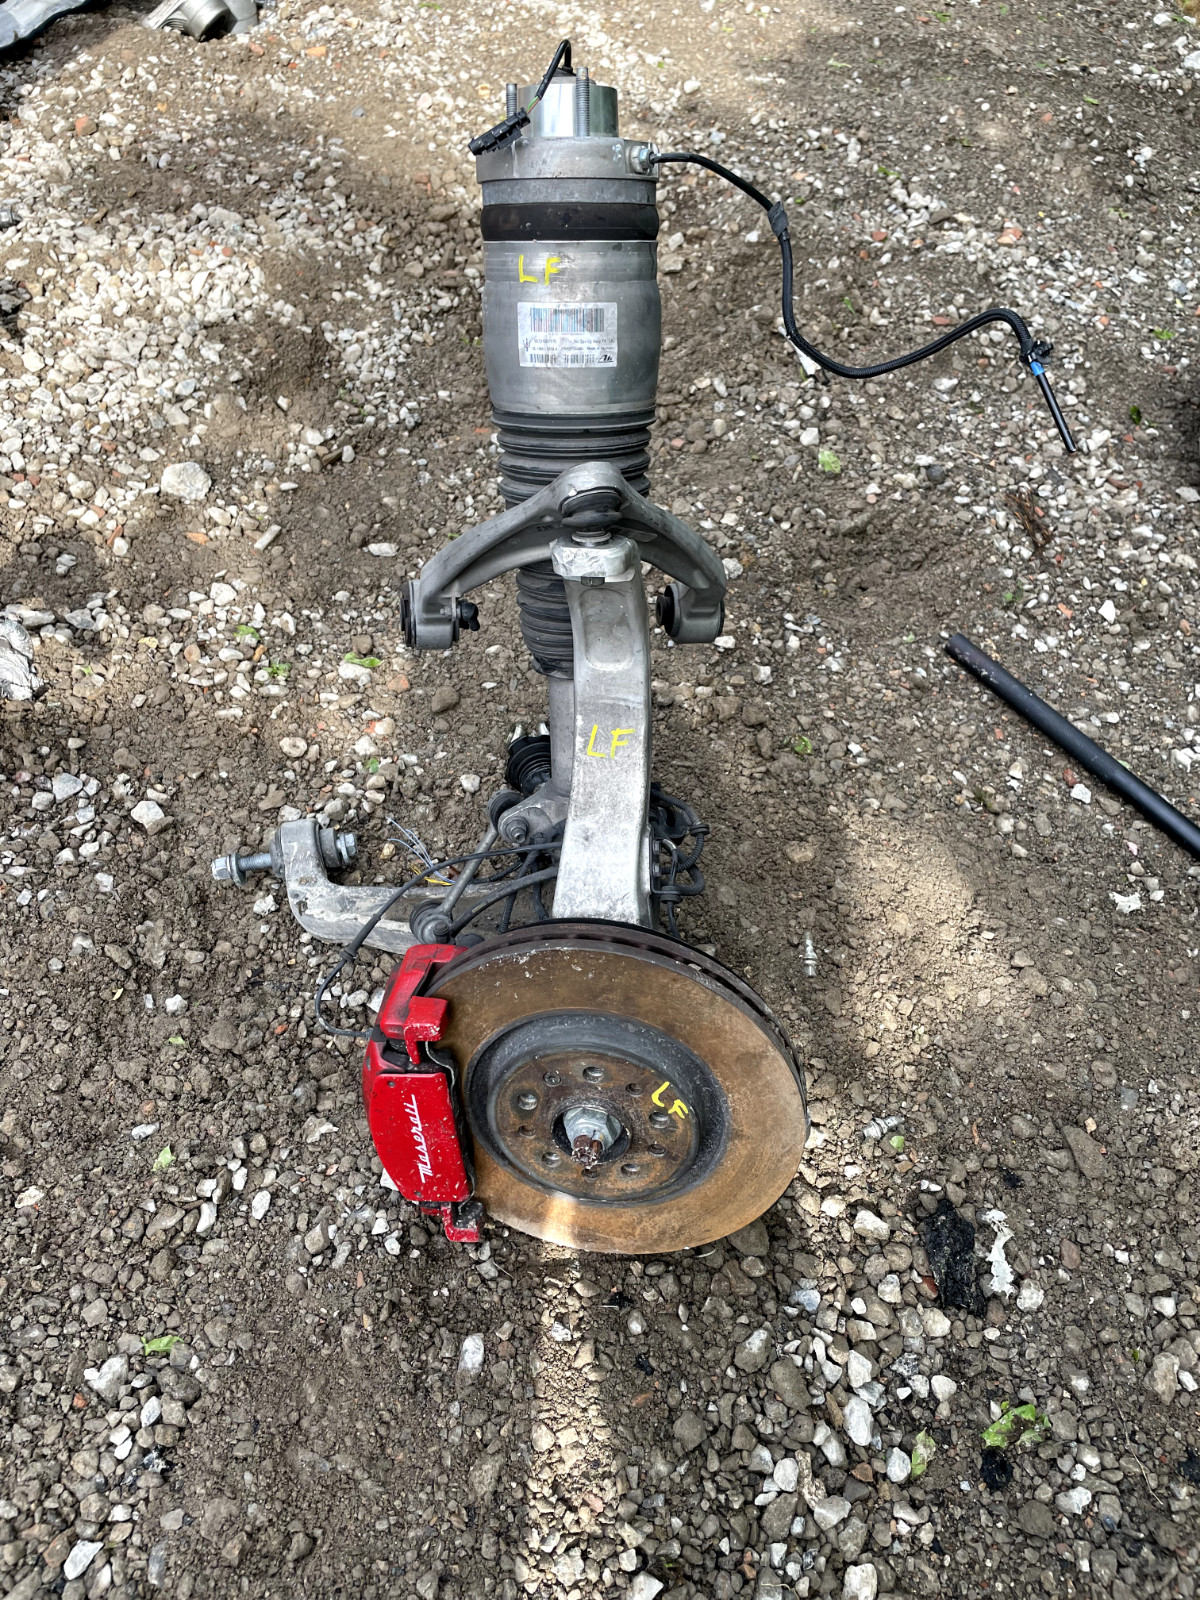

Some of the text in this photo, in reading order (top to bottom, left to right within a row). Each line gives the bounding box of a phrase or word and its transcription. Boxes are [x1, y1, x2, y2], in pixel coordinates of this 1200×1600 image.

[586, 723, 637, 760] LF
[651, 1081, 689, 1119] LF
[403, 1094, 434, 1184] Maserati
